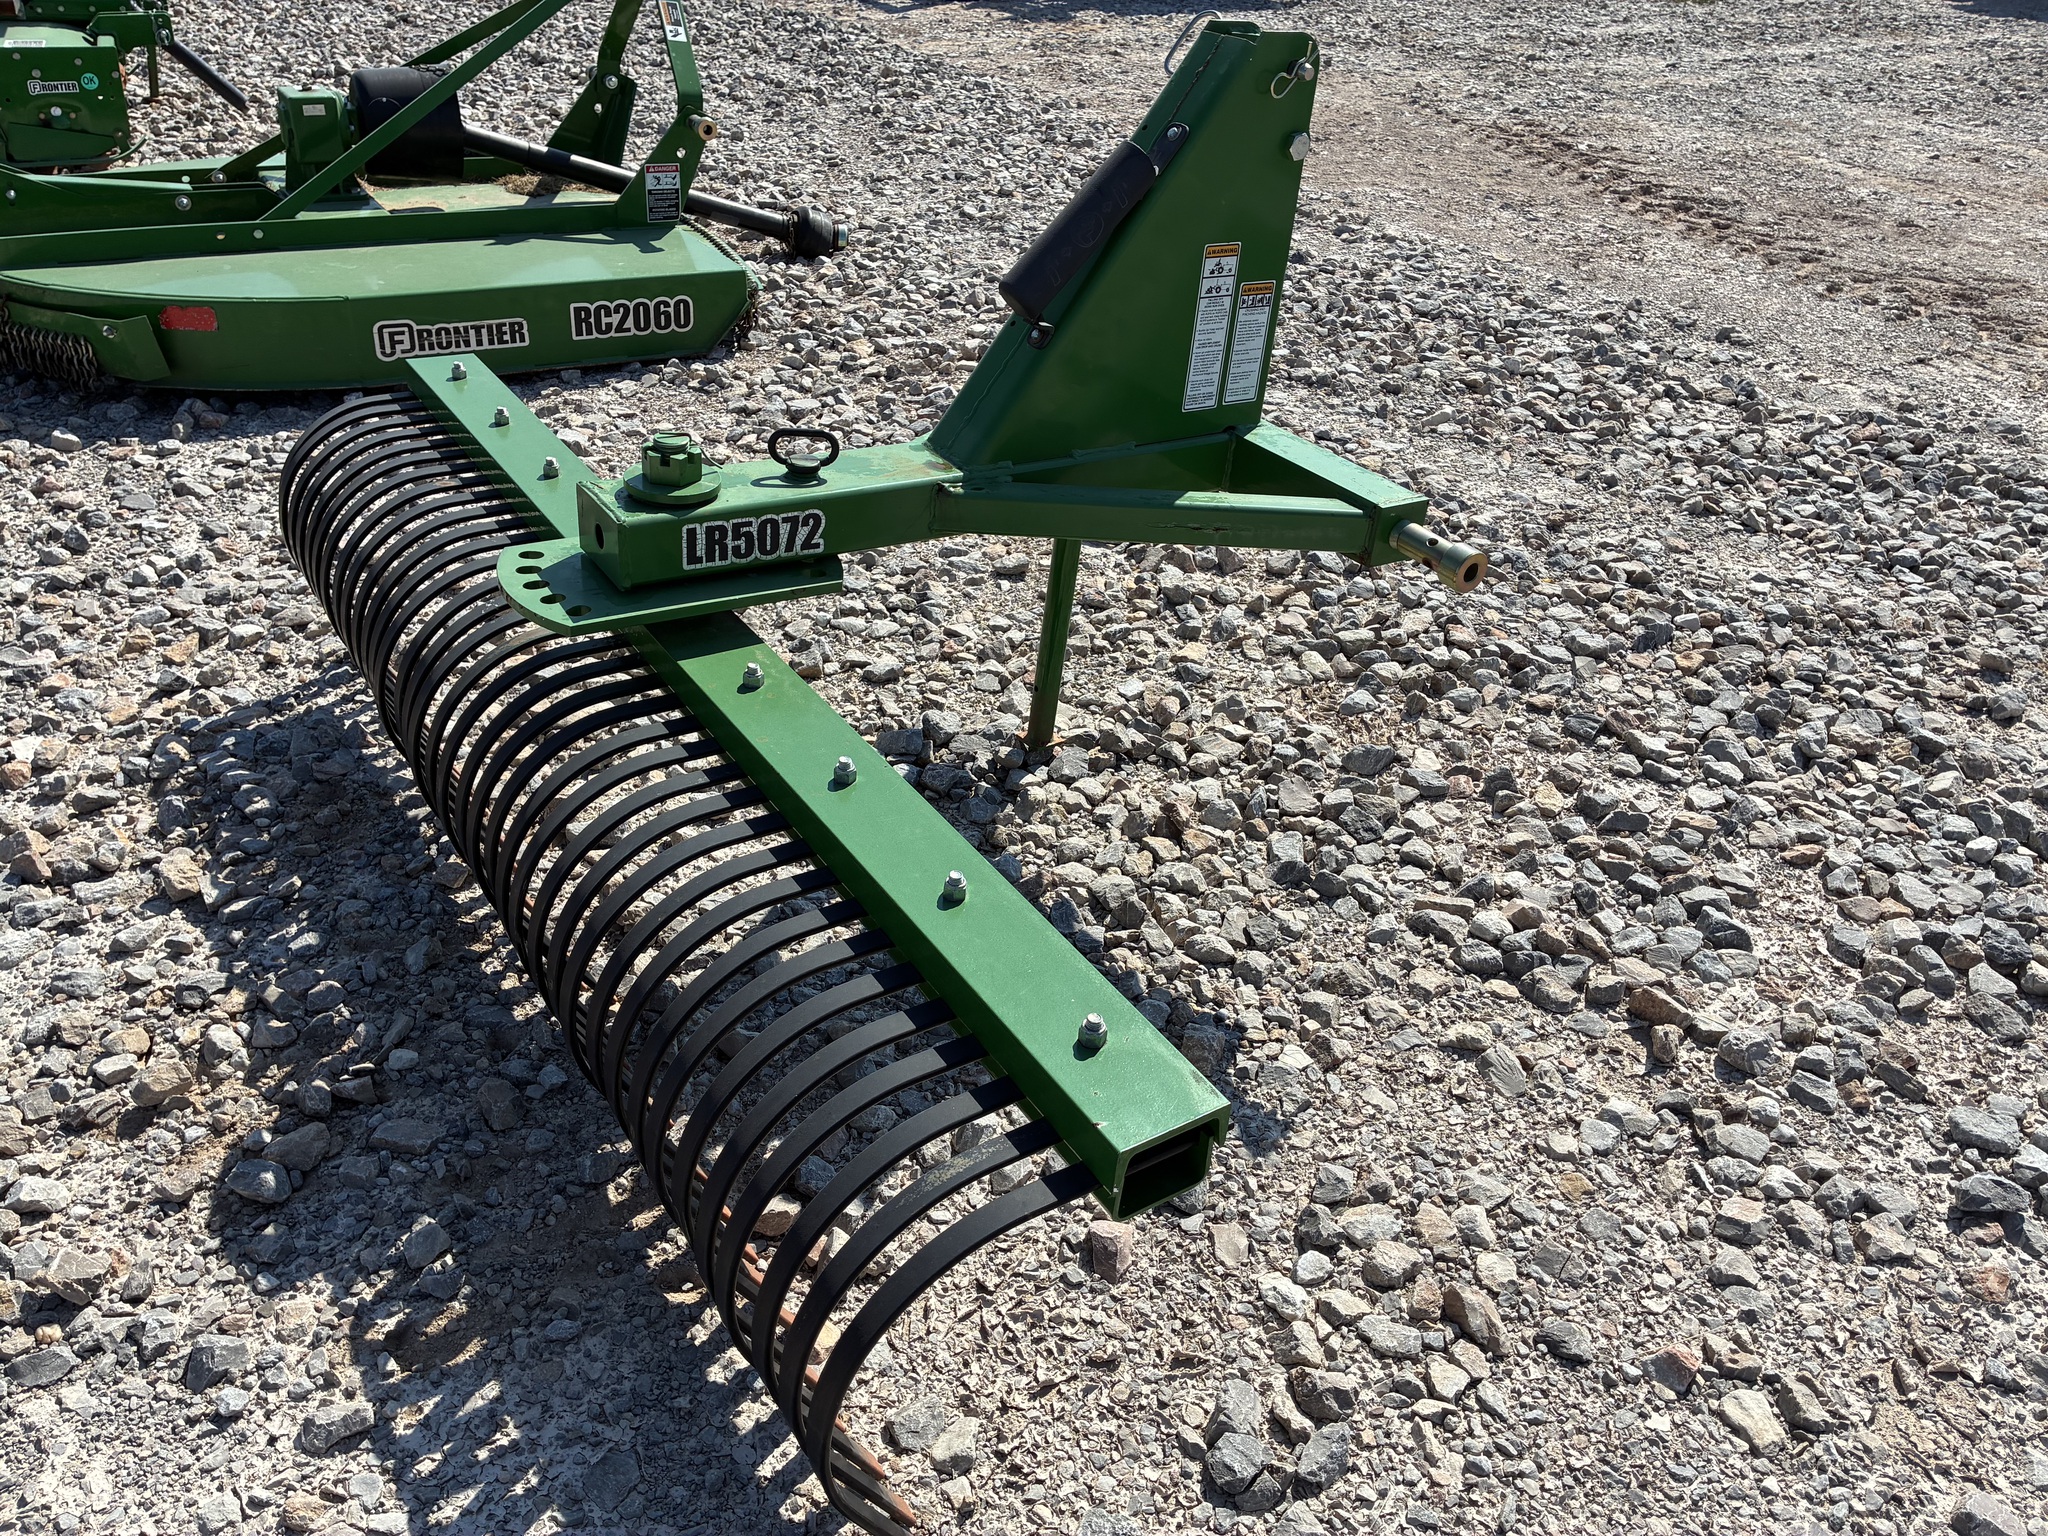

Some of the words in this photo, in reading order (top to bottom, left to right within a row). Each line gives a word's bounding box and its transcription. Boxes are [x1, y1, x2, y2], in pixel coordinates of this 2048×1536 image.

[83, 76, 96, 85] OK
[29, 81, 78, 94] FRONTIER
[1211, 247, 1238, 255] WARNING
[1247, 285, 1272, 293] WARNING
[573, 298, 692, 338] RC2060
[377, 320, 526, 358] FRONTIER
[686, 512, 823, 566] LR5072
